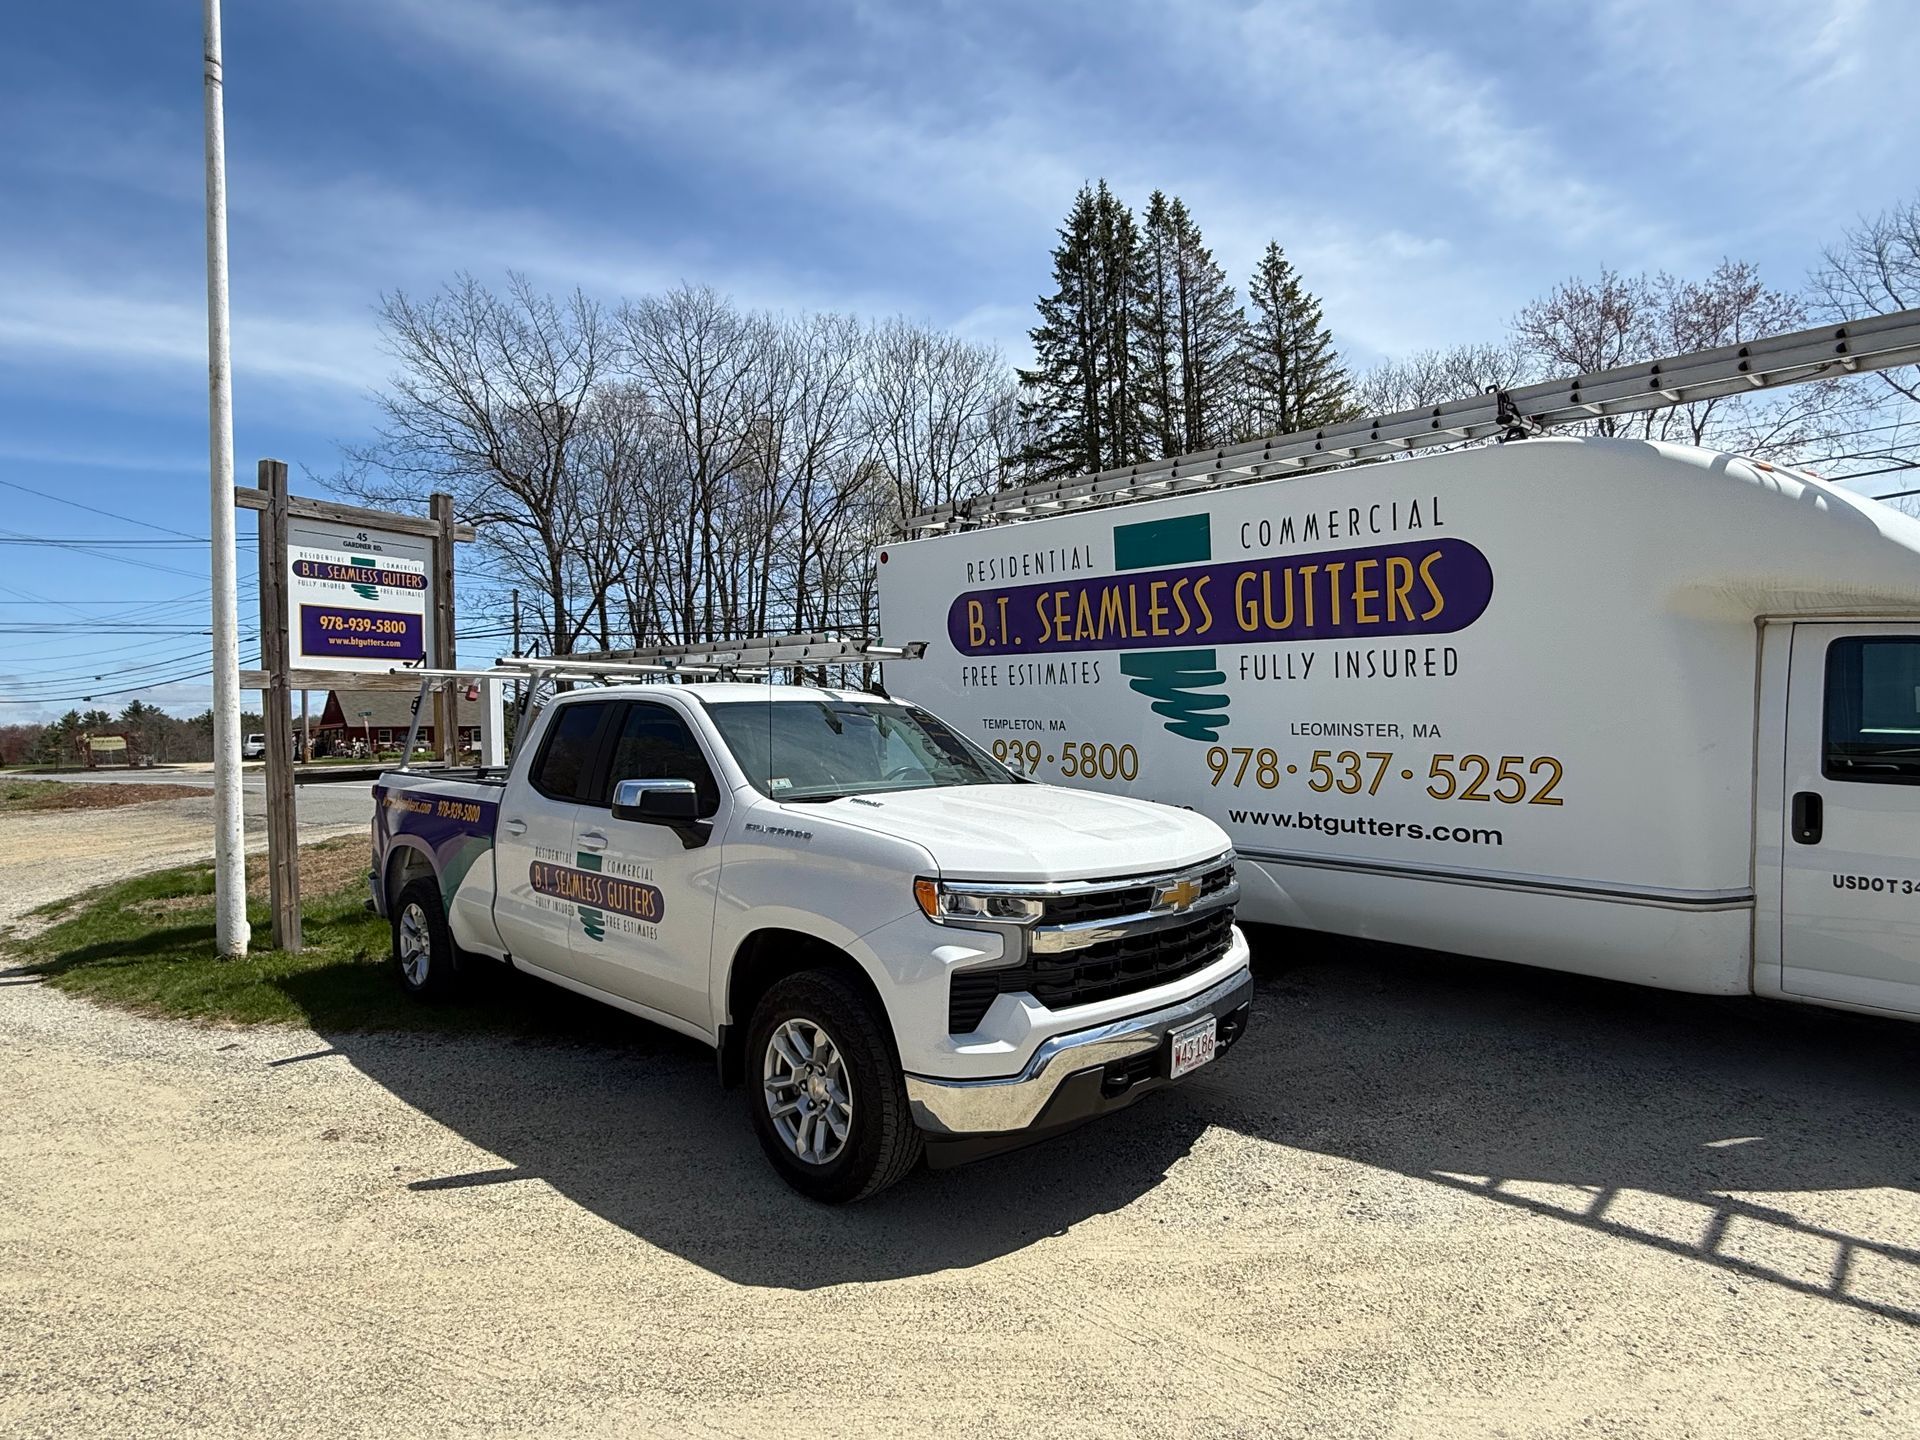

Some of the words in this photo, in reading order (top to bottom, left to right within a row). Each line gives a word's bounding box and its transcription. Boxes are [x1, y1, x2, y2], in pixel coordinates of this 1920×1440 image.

[1240, 496, 1444, 549] COMMERCIAL
[343, 540, 372, 552] GARDNER
[356, 532, 368, 542] 45
[299, 551, 345, 563] RESIDENTIAL
[382, 561, 422, 573] COMMERCIAL
[967, 545, 1093, 583] RESIDENTIAL
[297, 579, 317, 588] FULLY
[319, 582, 346, 591] INSURED
[302, 562, 323, 578] B.T.
[327, 564, 379, 584] SEAMLESS
[382, 571, 423, 589] GUTTERS
[380, 587, 394, 595] FREE
[396, 590, 424, 599] ESTIMATES
[968, 597, 1022, 647] B.T.
[1036, 575, 1213, 644] SEAMLESS
[1234, 550, 1445, 632] GUTTERS
[320, 615, 406, 634] 978-939-5800
[328, 636, 401, 648] www.btgutters.com
[962, 665, 998, 687] FREE
[1008, 661, 1101, 686] ESTIMATES
[1240, 652, 1315, 681] FULLY
[1334, 647, 1458, 679] INSURED
[982, 718, 1045, 732] TEMPLETON,
[1049, 720, 1067, 731] MA
[1290, 722, 1405, 740] LEOMINSTER,
[1412, 723, 1441, 738] MA
[437, 800, 481, 823] 978-939-5800
[1228, 809, 1503, 846] www.btgutters.com
[535, 846, 572, 865] RESIDENTIAL
[607, 860, 654, 881] COMMERCIAL
[535, 865, 552, 892] B.T.
[555, 869, 603, 904] SEAMLESS
[607, 881, 656, 917] GUTTERS
[1833, 874, 1898, 894] USDOT
[535, 896, 550, 911] FULLY
[552, 901, 575, 917] INSURED
[605, 915, 620, 930] FREE
[623, 920, 658, 941] ESTIMATES
